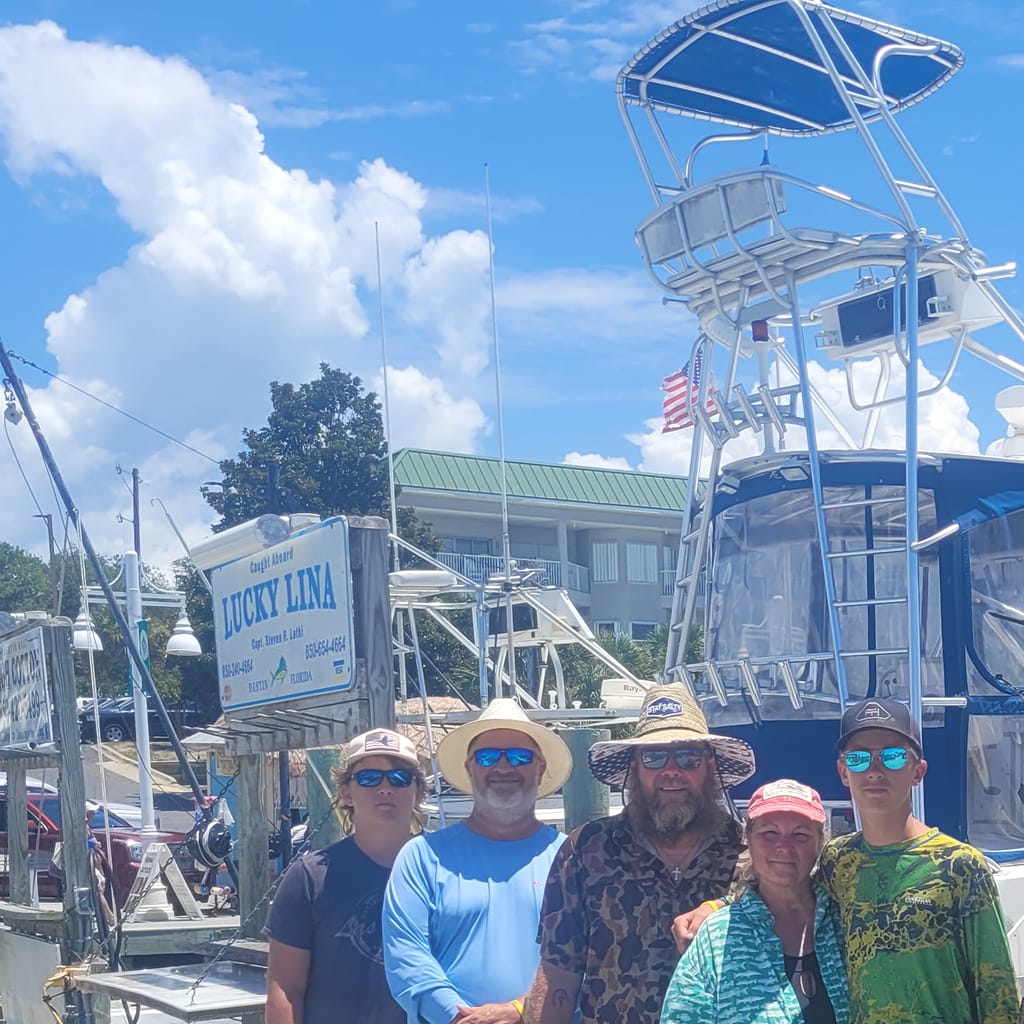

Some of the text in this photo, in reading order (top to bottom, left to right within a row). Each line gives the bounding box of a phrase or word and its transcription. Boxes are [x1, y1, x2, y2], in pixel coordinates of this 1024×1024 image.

[249, 547, 294, 574] Caught Aboard
[221, 561, 336, 640] LUCKY LINA
[251, 637, 264, 651] Capt.
[290, 669, 313, 685] FLORIDA
